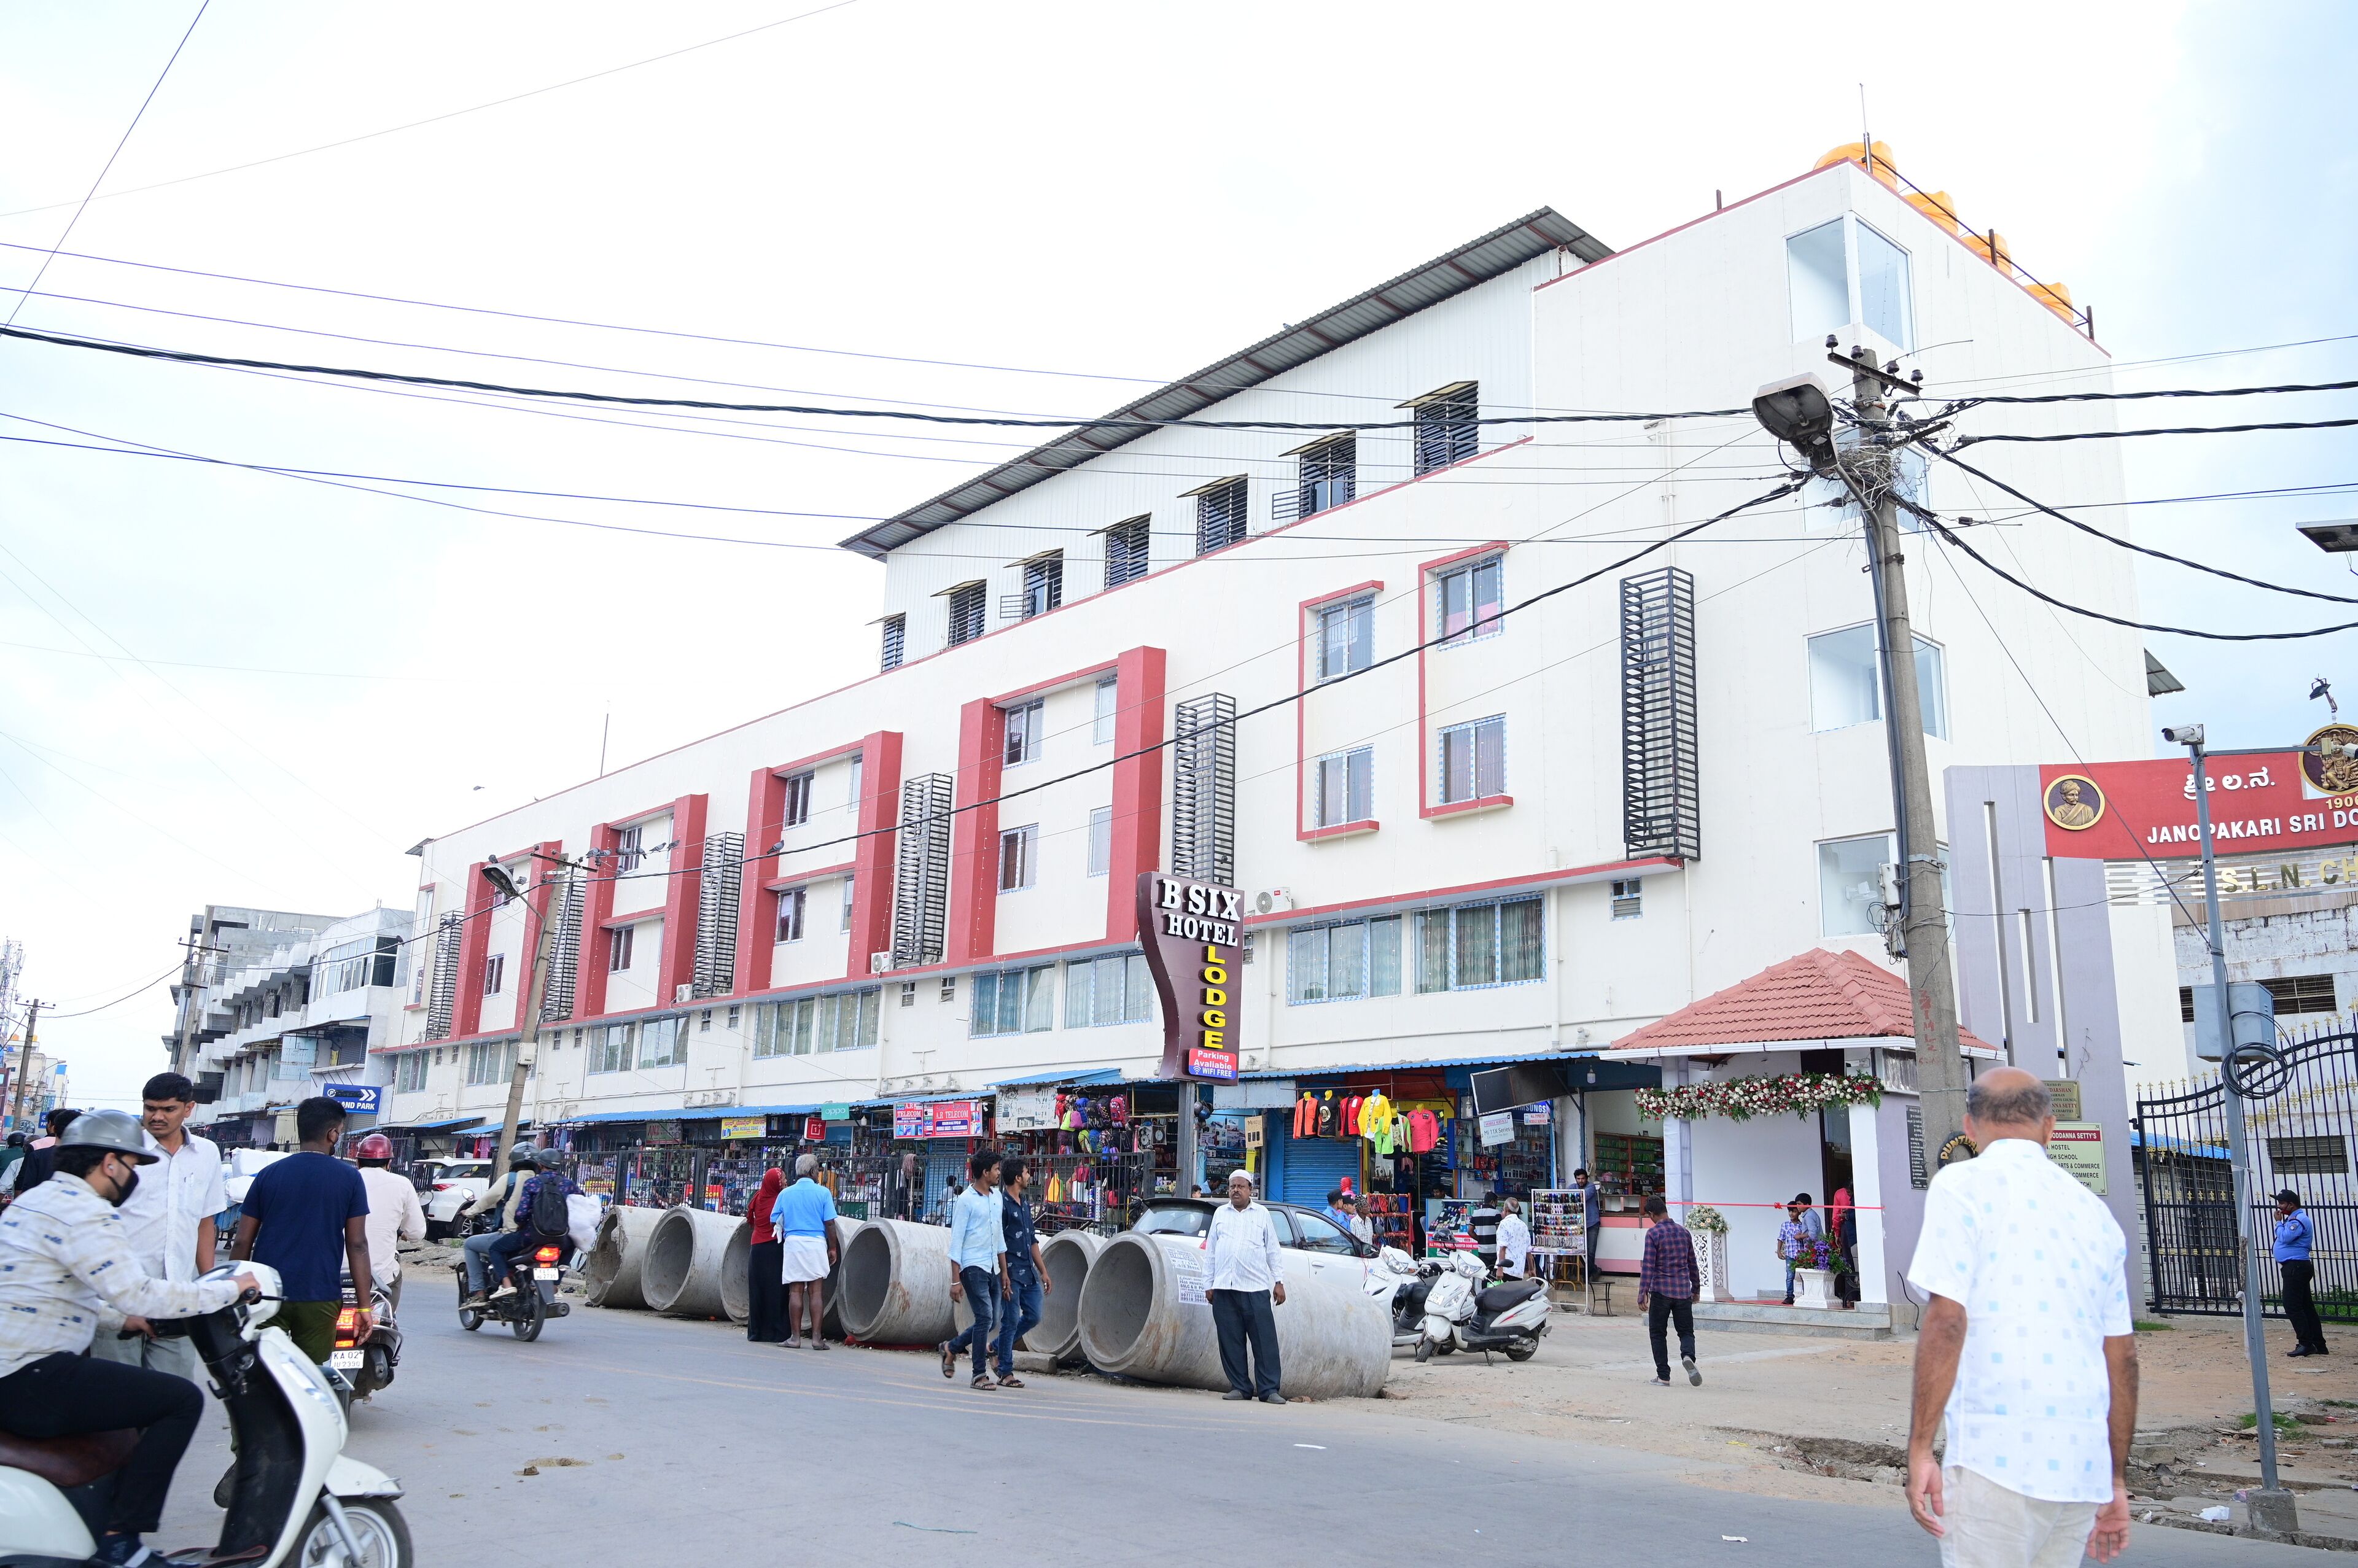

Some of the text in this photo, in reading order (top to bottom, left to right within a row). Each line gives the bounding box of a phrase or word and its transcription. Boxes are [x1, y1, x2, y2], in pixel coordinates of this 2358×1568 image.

[2147, 818, 2281, 844] JANOPAKARI
[2289, 813, 2325, 833] SRI
[1162, 878, 1241, 922] B SIX
[1168, 913, 1238, 947] HOTEL
[1203, 945, 1228, 1049] LODGE
[1194, 1058, 1232, 1070] Avaliable
[1197, 1050, 1229, 1063] Parking
[1202, 1067, 1232, 1077] WIFI FREE
